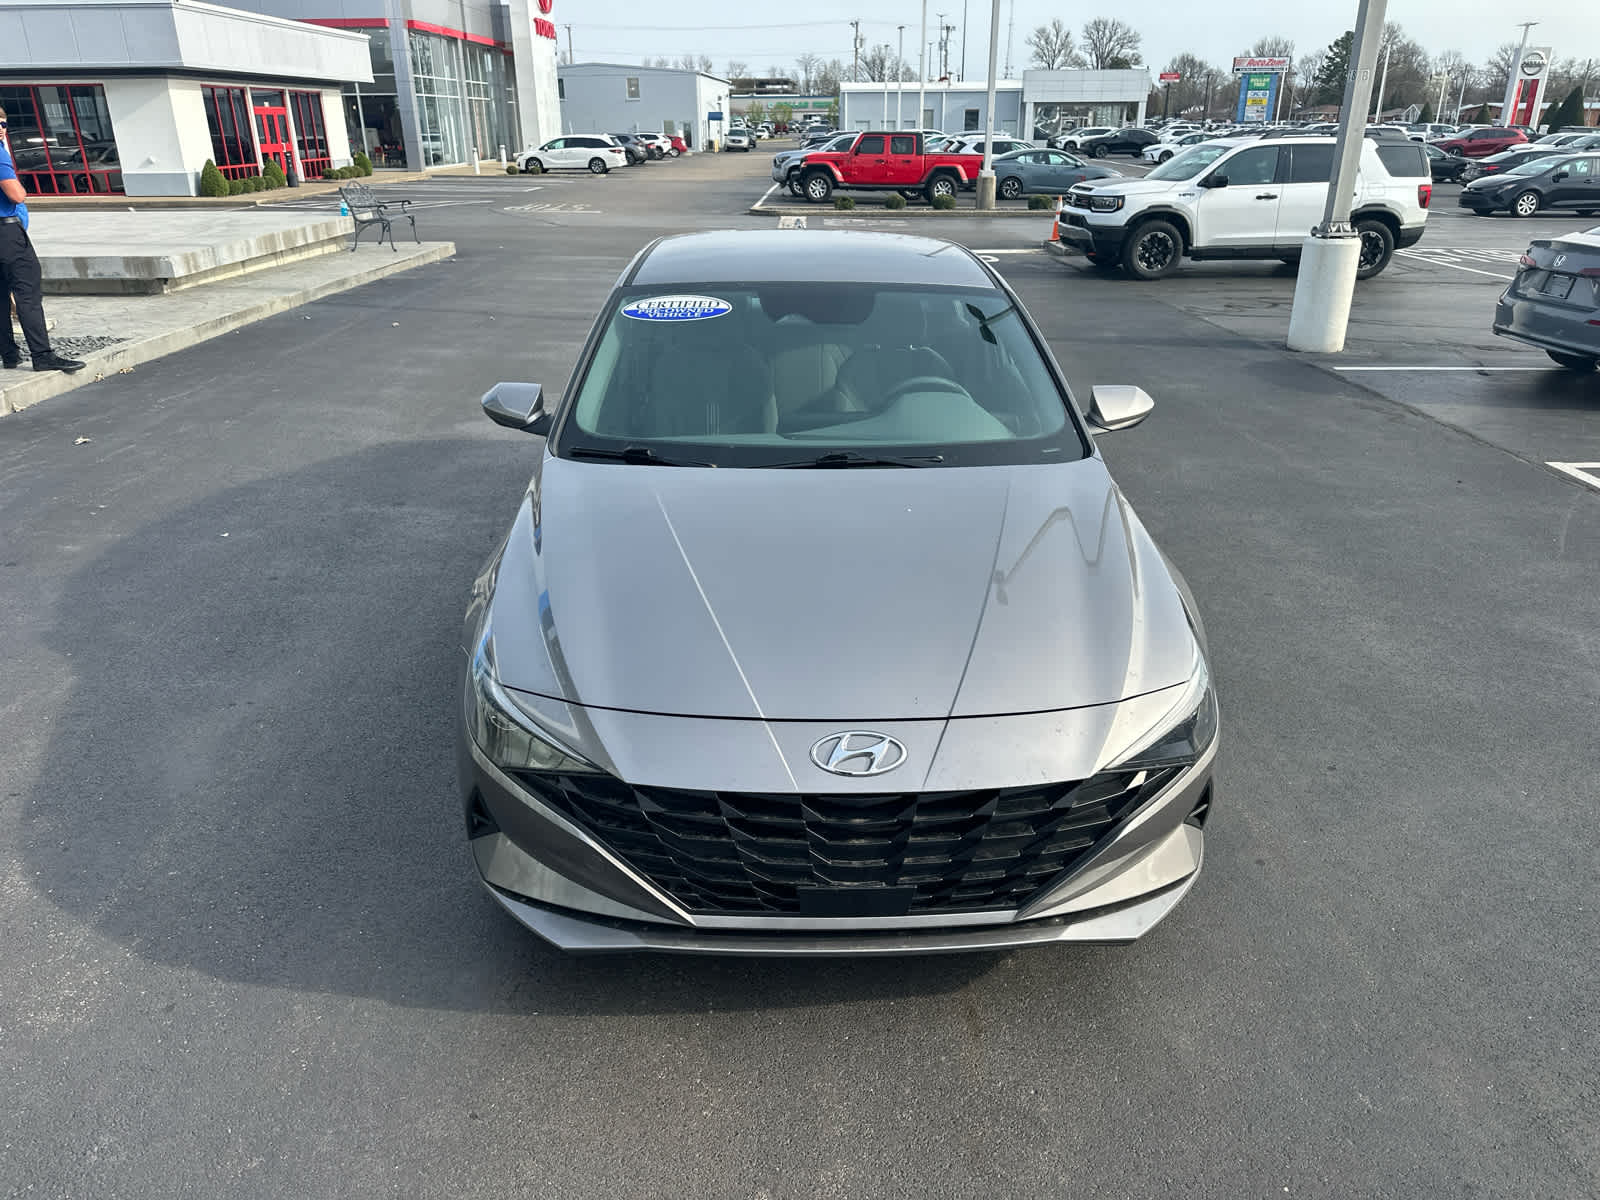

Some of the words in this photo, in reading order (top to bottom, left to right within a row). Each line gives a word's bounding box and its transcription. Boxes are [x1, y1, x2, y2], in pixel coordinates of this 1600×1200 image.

[1247, 58, 1286, 66] AutoZone
[636, 300, 721, 309] CERTIFIED
[637, 307, 714, 315] PRE-OWNED
